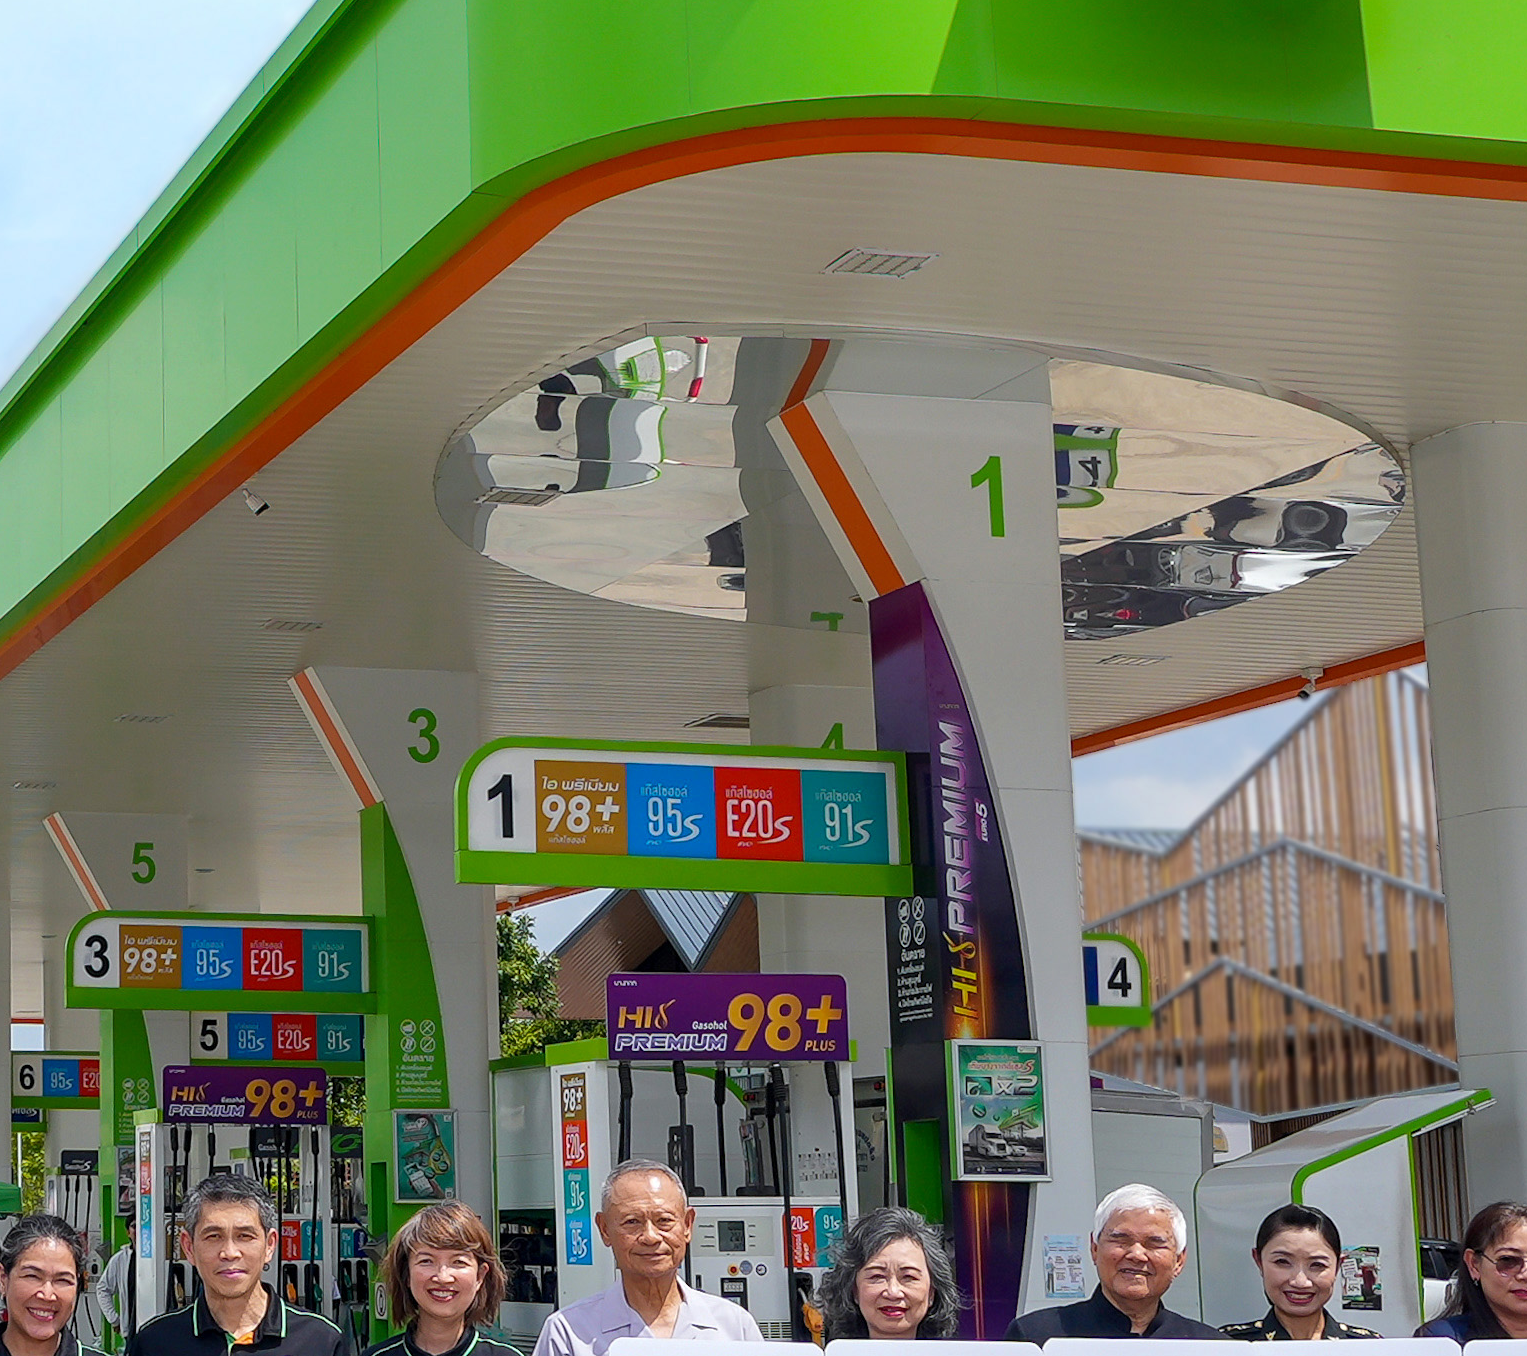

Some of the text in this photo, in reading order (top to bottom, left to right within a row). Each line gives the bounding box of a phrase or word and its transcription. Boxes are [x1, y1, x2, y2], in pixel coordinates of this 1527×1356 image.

[970, 456, 1005, 537] 1
[407, 708, 440, 764] 3
[563, 777, 620, 793] พรีเมียม
[725, 784, 773, 800] แก๊สโซฮอล์
[486, 774, 515, 839] 1
[938, 720, 976, 935] PREMIUM
[131, 842, 156, 884] 5
[84, 935, 110, 979] 3
[1107, 956, 1132, 998] 4
[200, 1019, 219, 1052] 5
[692, 1020, 728, 1031] Gasohol
[615, 1033, 728, 1052] PREMIUM
[804, 1039, 836, 1052] PLUS
[19, 1064, 35, 1090] 6
[168, 1104, 246, 1118] PREMIUM
[297, 1110, 319, 1119] PLUS
